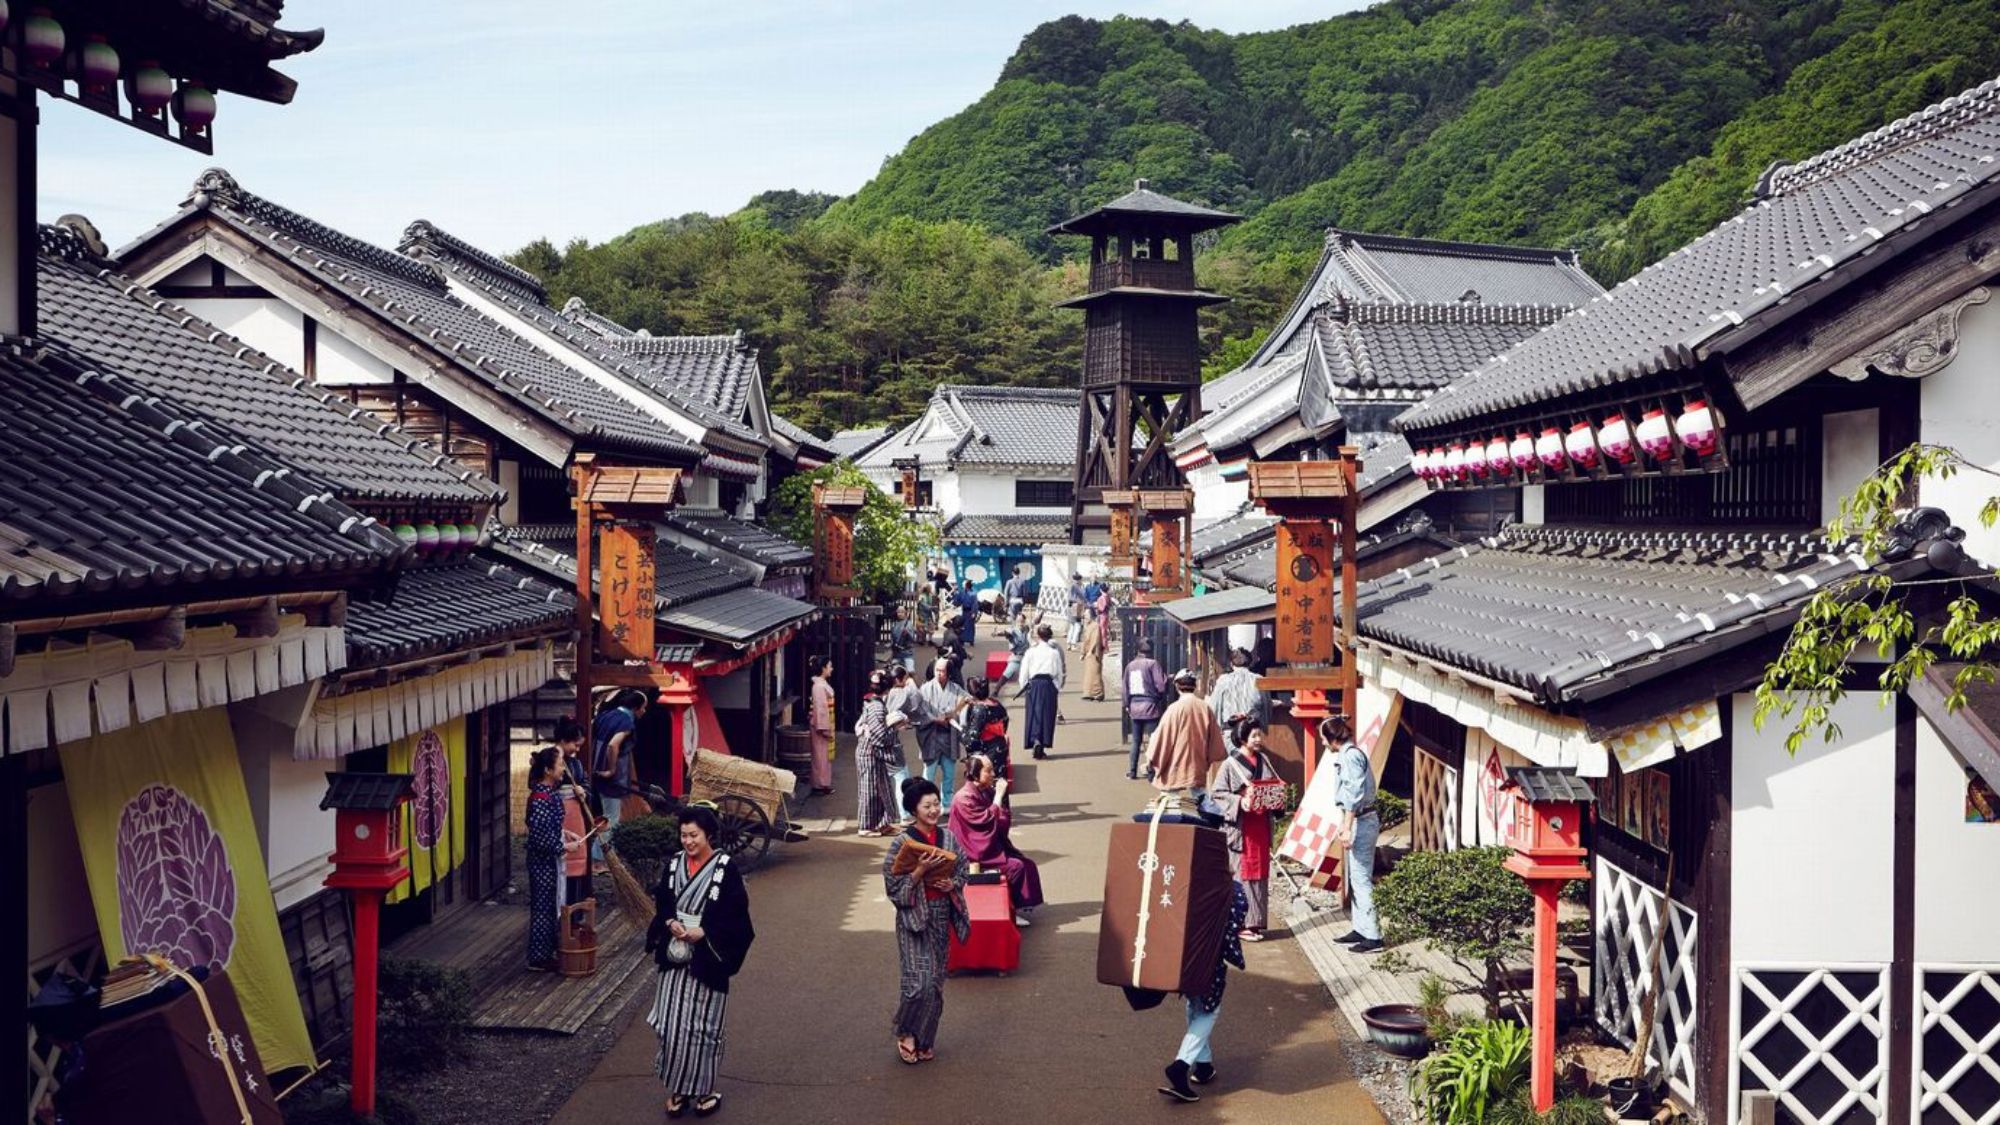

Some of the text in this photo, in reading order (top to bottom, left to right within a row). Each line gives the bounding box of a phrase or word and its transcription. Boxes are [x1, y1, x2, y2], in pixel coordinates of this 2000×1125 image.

[611, 555, 631, 643] こけし堂
[1159, 864, 1175, 908] 貸本
